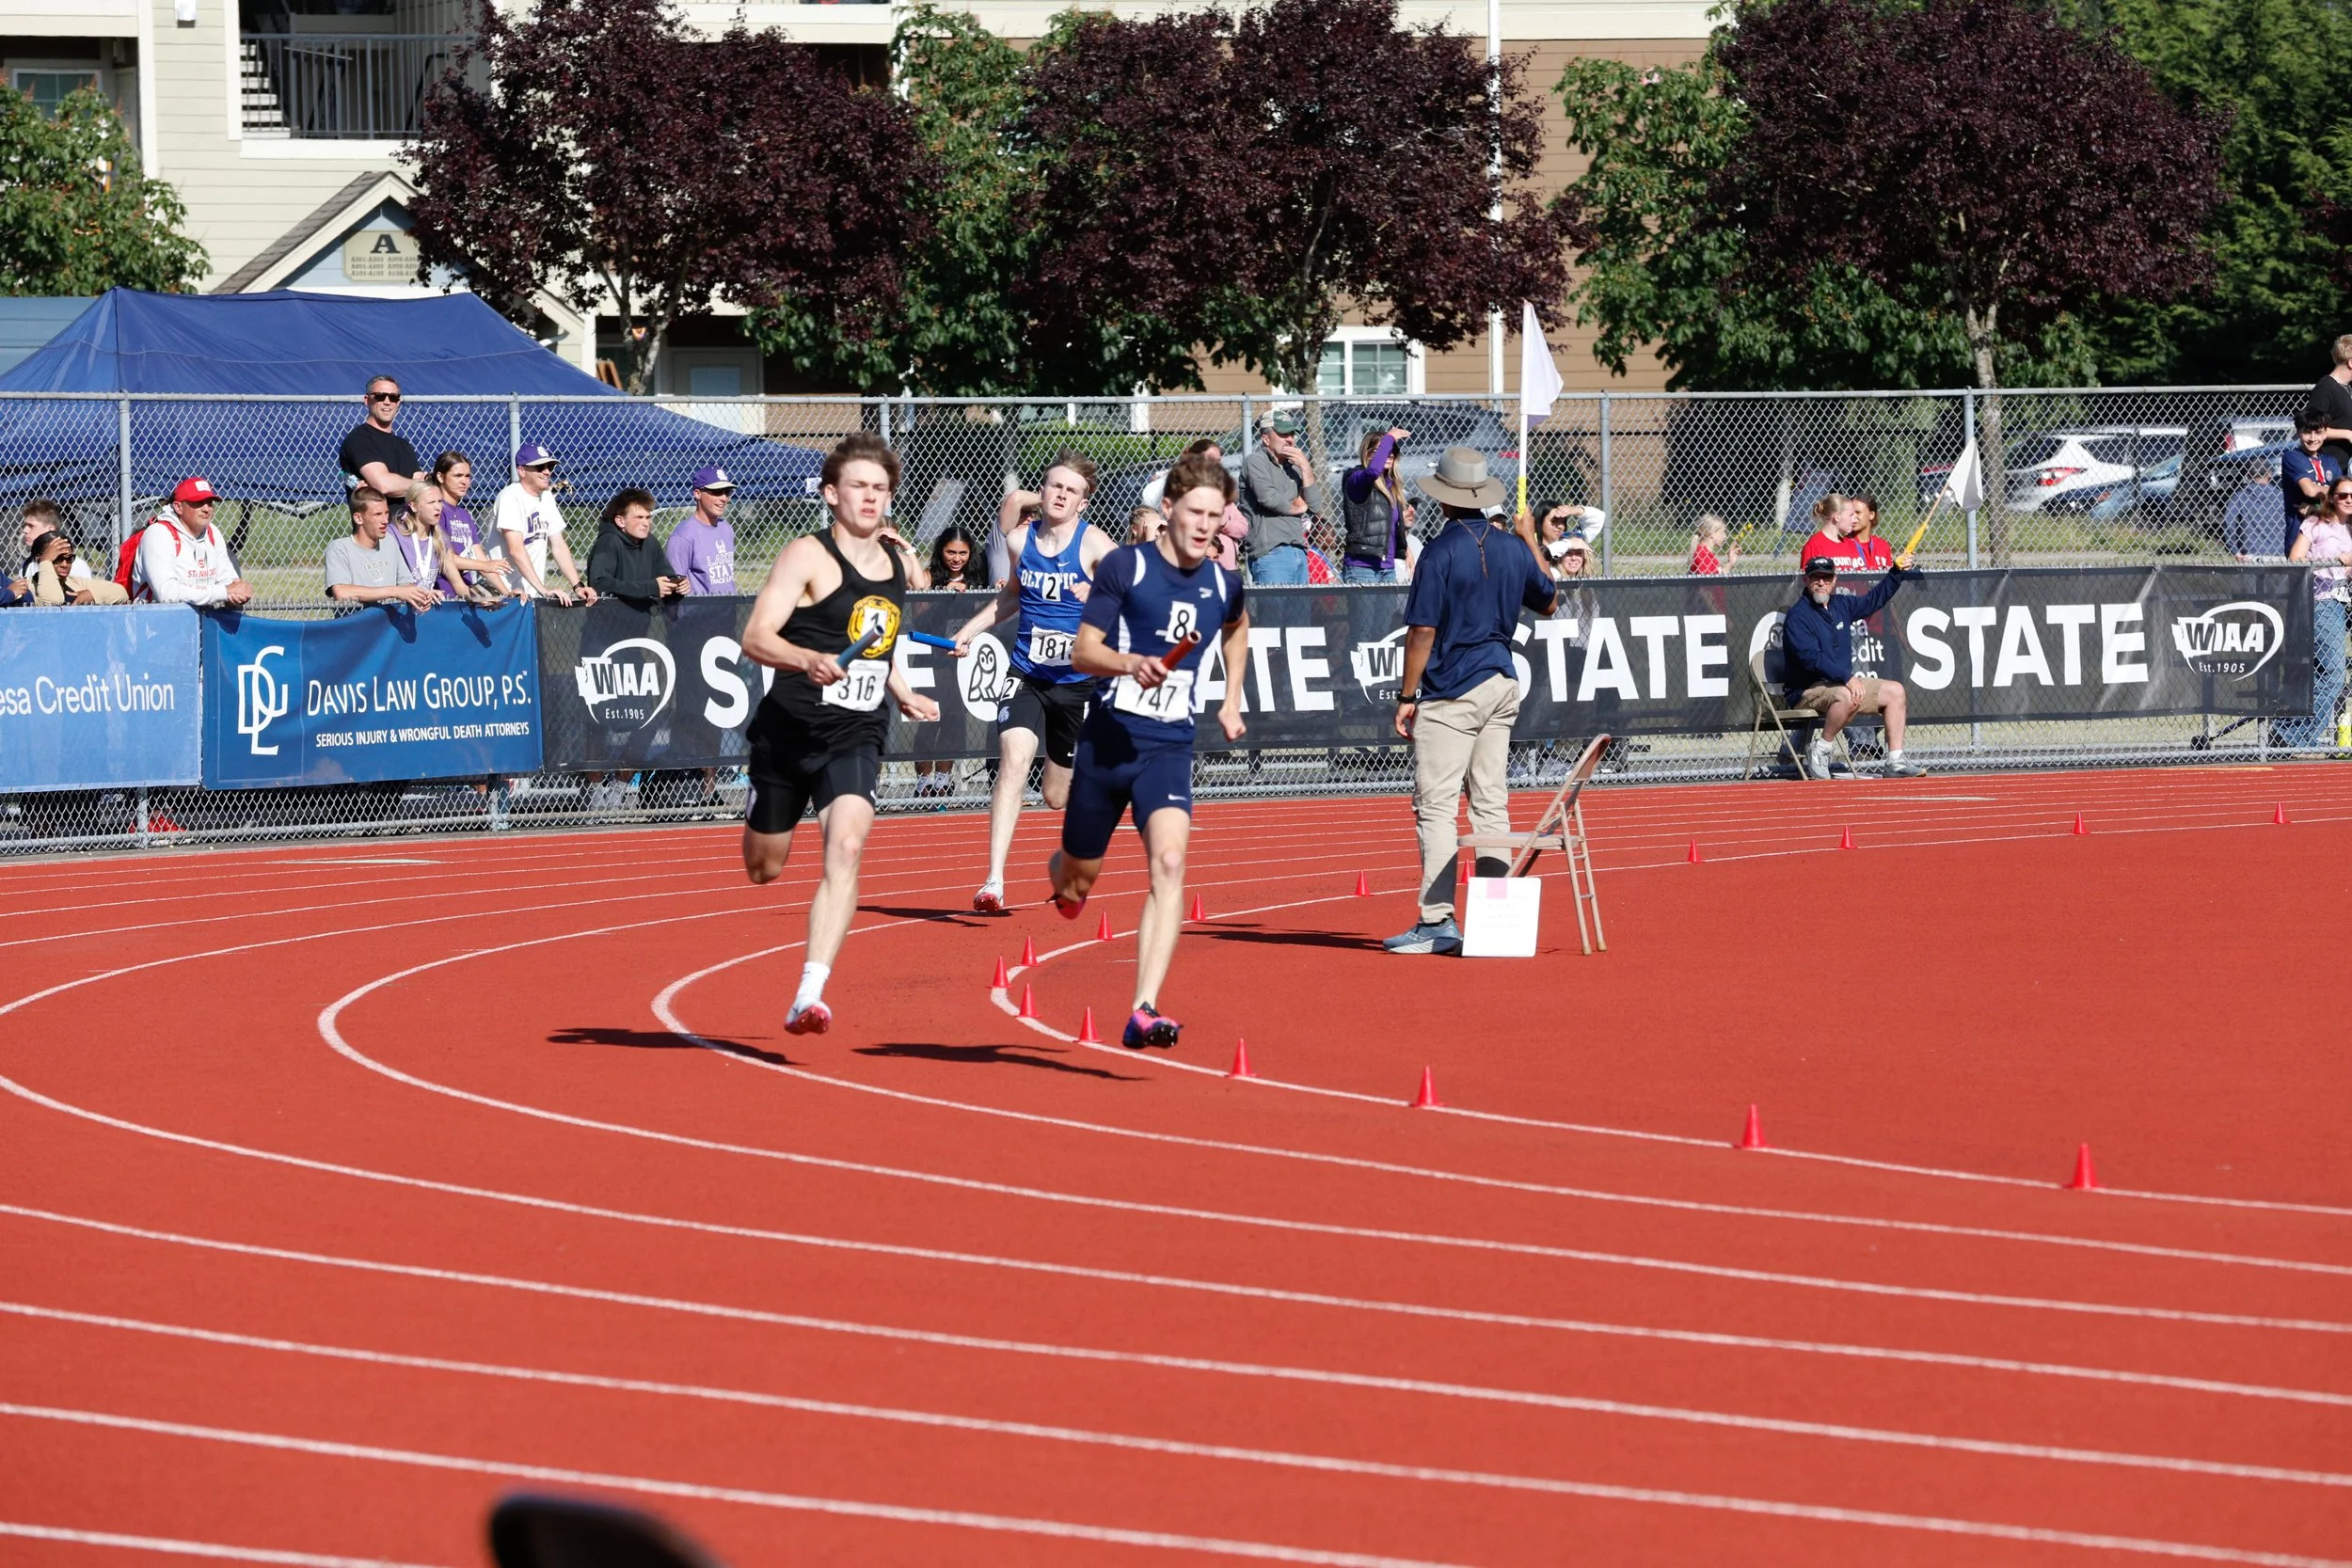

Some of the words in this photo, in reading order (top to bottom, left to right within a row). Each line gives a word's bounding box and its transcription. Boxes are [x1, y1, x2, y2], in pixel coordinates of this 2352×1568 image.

[370, 233, 401, 254] A
[1021, 569, 1078, 590] OLYIC
[1045, 576, 1057, 600] 2
[1173, 609, 1190, 641] 8
[2185, 622, 2265, 653] WIAA
[1906, 603, 2149, 690] STATE
[590, 662, 660, 696] WIAA
[1193, 626, 1335, 714] ATE
[2199, 662, 2246, 673] Est.1905
[35, 673, 112, 715] Credit
[114, 673, 175, 712] Union
[837, 675, 876, 702] 316
[1003, 678, 1014, 698] 2
[605, 707, 645, 721] Est.1905
[315, 732, 354, 748] SERIOUS
[356, 729, 388, 745] INJURY
[389, 728, 398, 743] &
[398, 725, 452, 742] WRONGFUL
[453, 724, 483, 739] DEATH
[485, 721, 530, 737] ATTORNEYS
